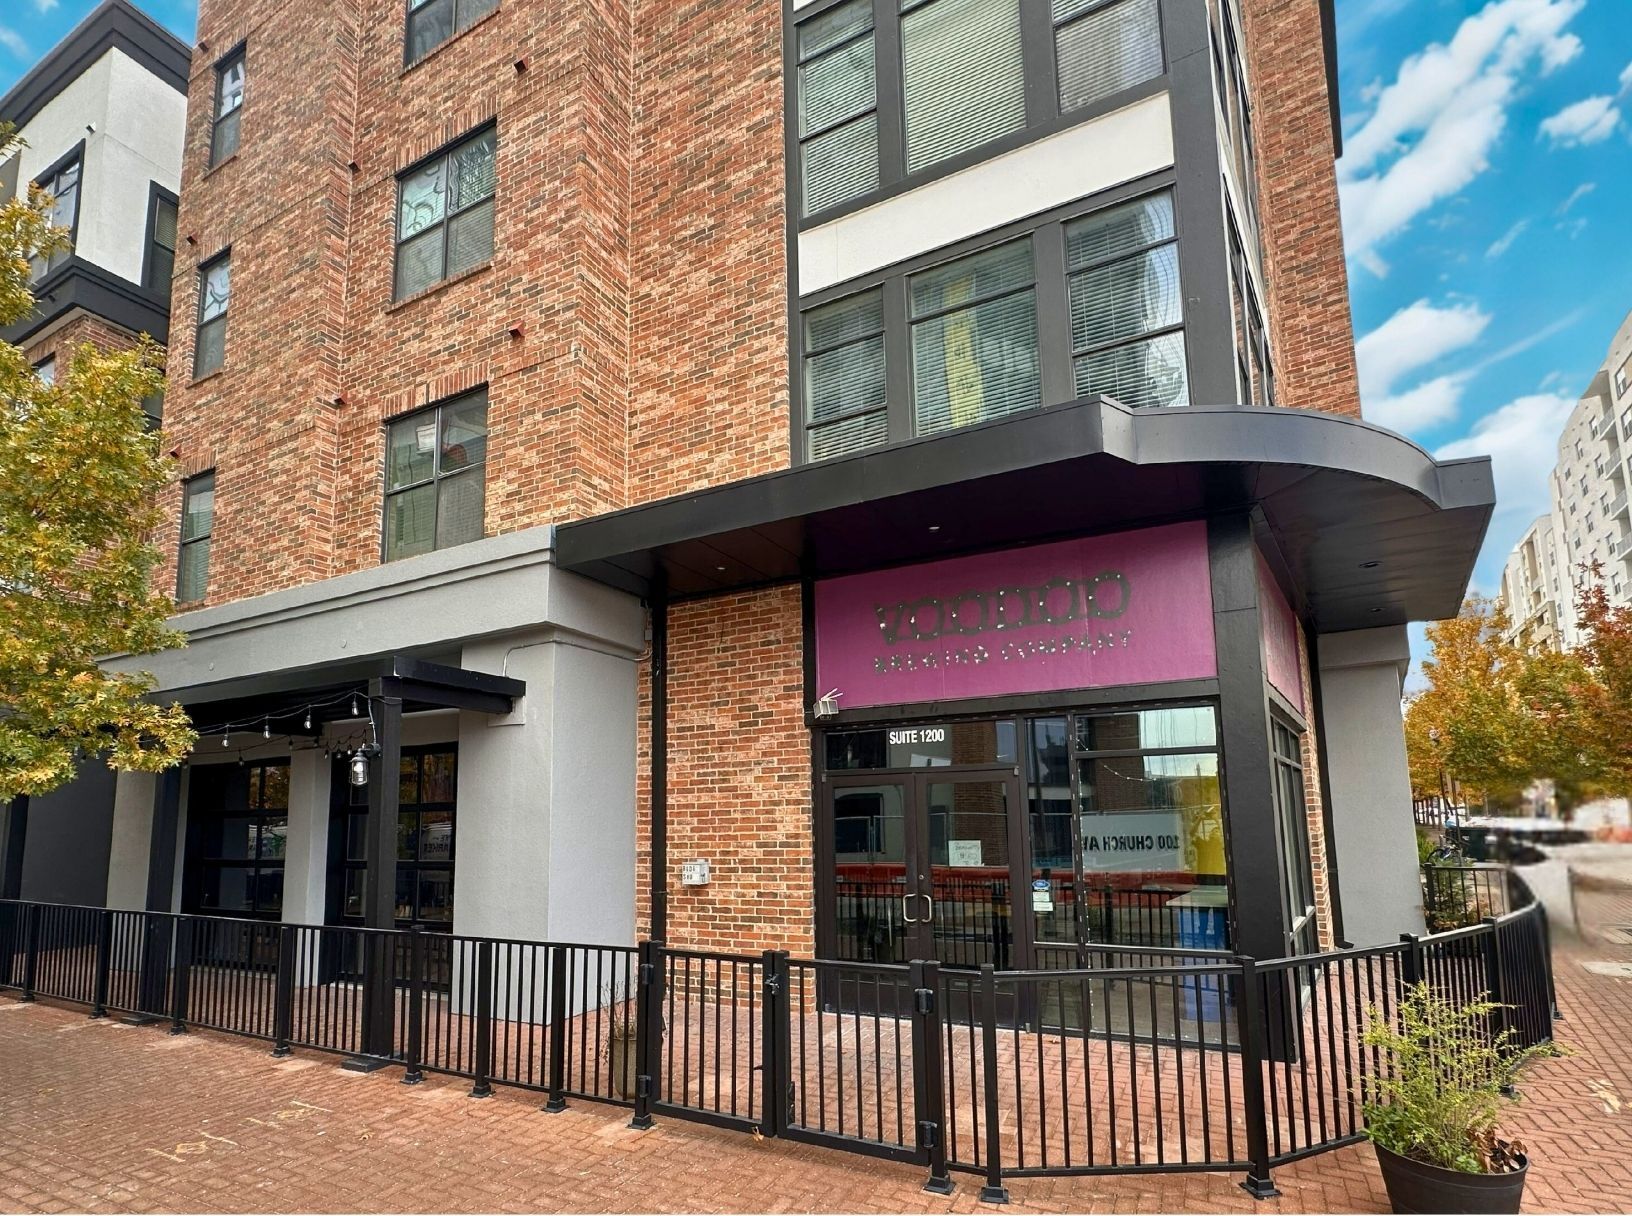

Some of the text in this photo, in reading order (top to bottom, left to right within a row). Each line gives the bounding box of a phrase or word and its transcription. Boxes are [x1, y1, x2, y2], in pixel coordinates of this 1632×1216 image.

[874, 570, 1132, 645] VOODOO
[889, 728, 945, 745] SUITE 1200
